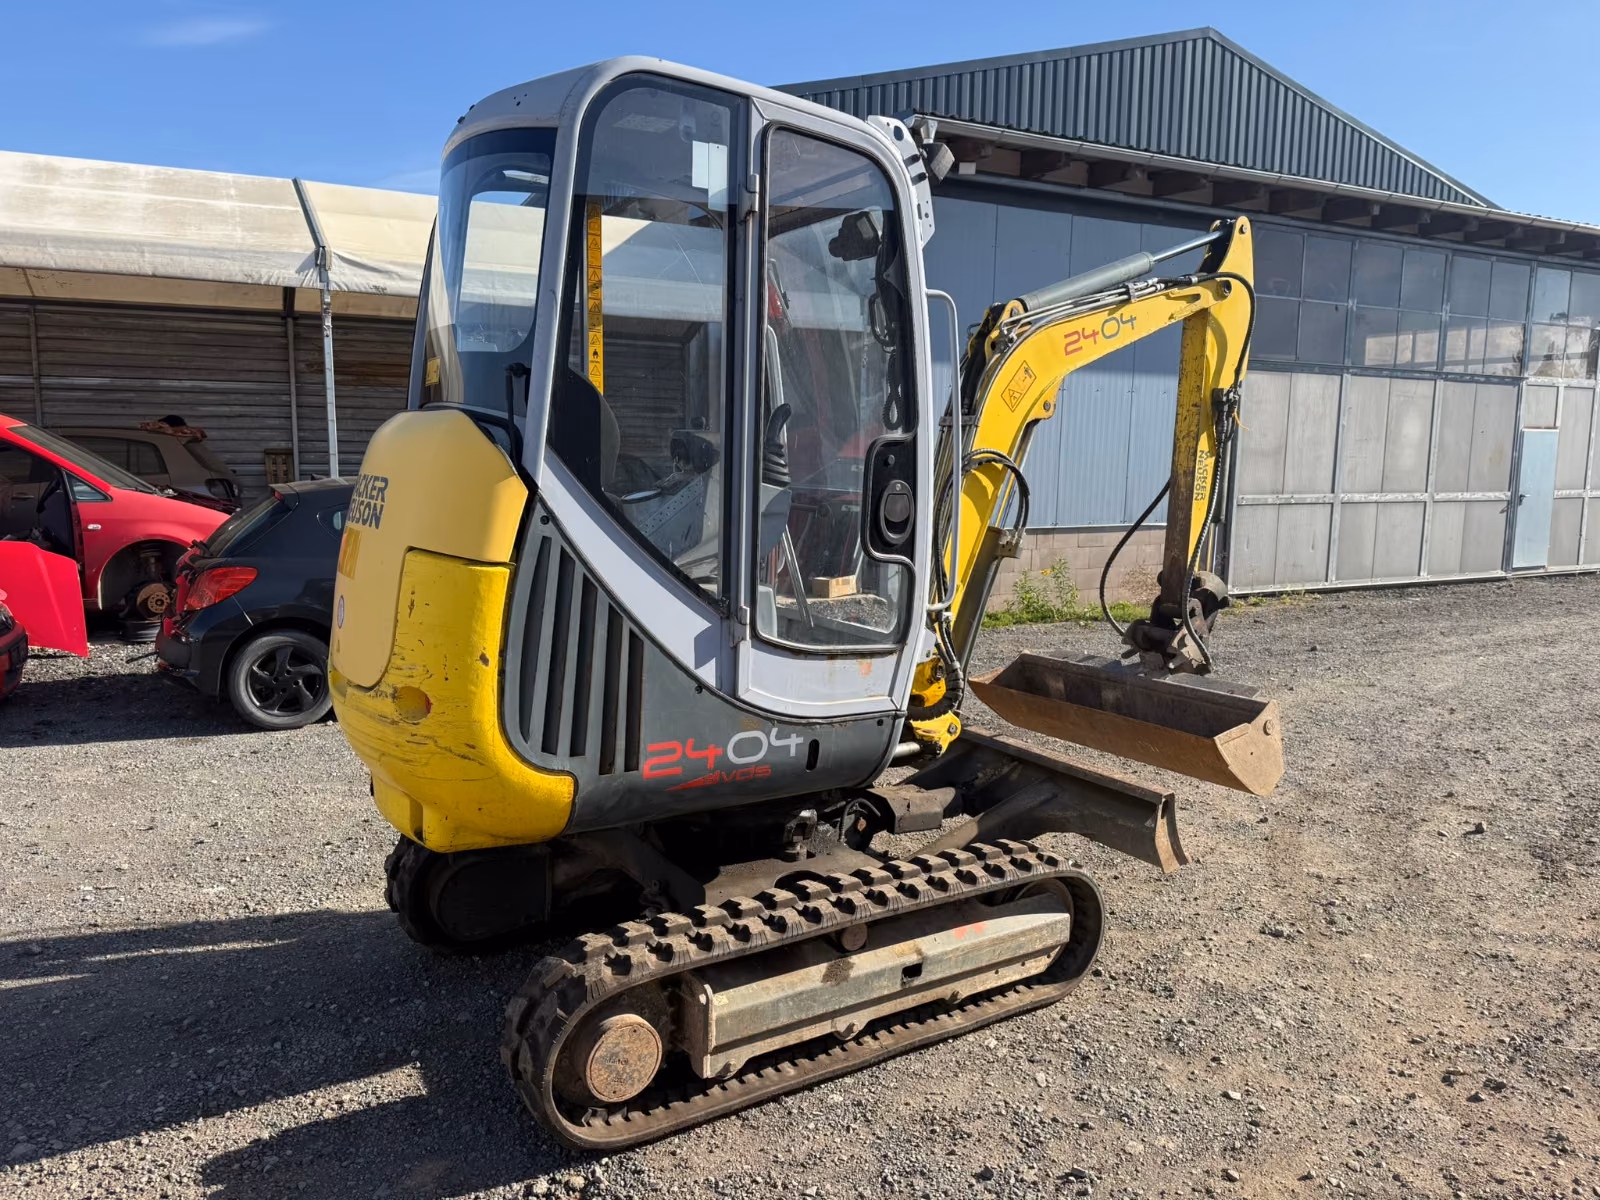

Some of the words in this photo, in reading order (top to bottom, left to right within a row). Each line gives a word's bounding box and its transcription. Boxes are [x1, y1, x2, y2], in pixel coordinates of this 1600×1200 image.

[1064, 313, 1136, 356] 2404
[353, 474, 389, 503] ACKER
[1194, 450, 1205, 501] NEUSON
[642, 727, 804, 780] 2404
